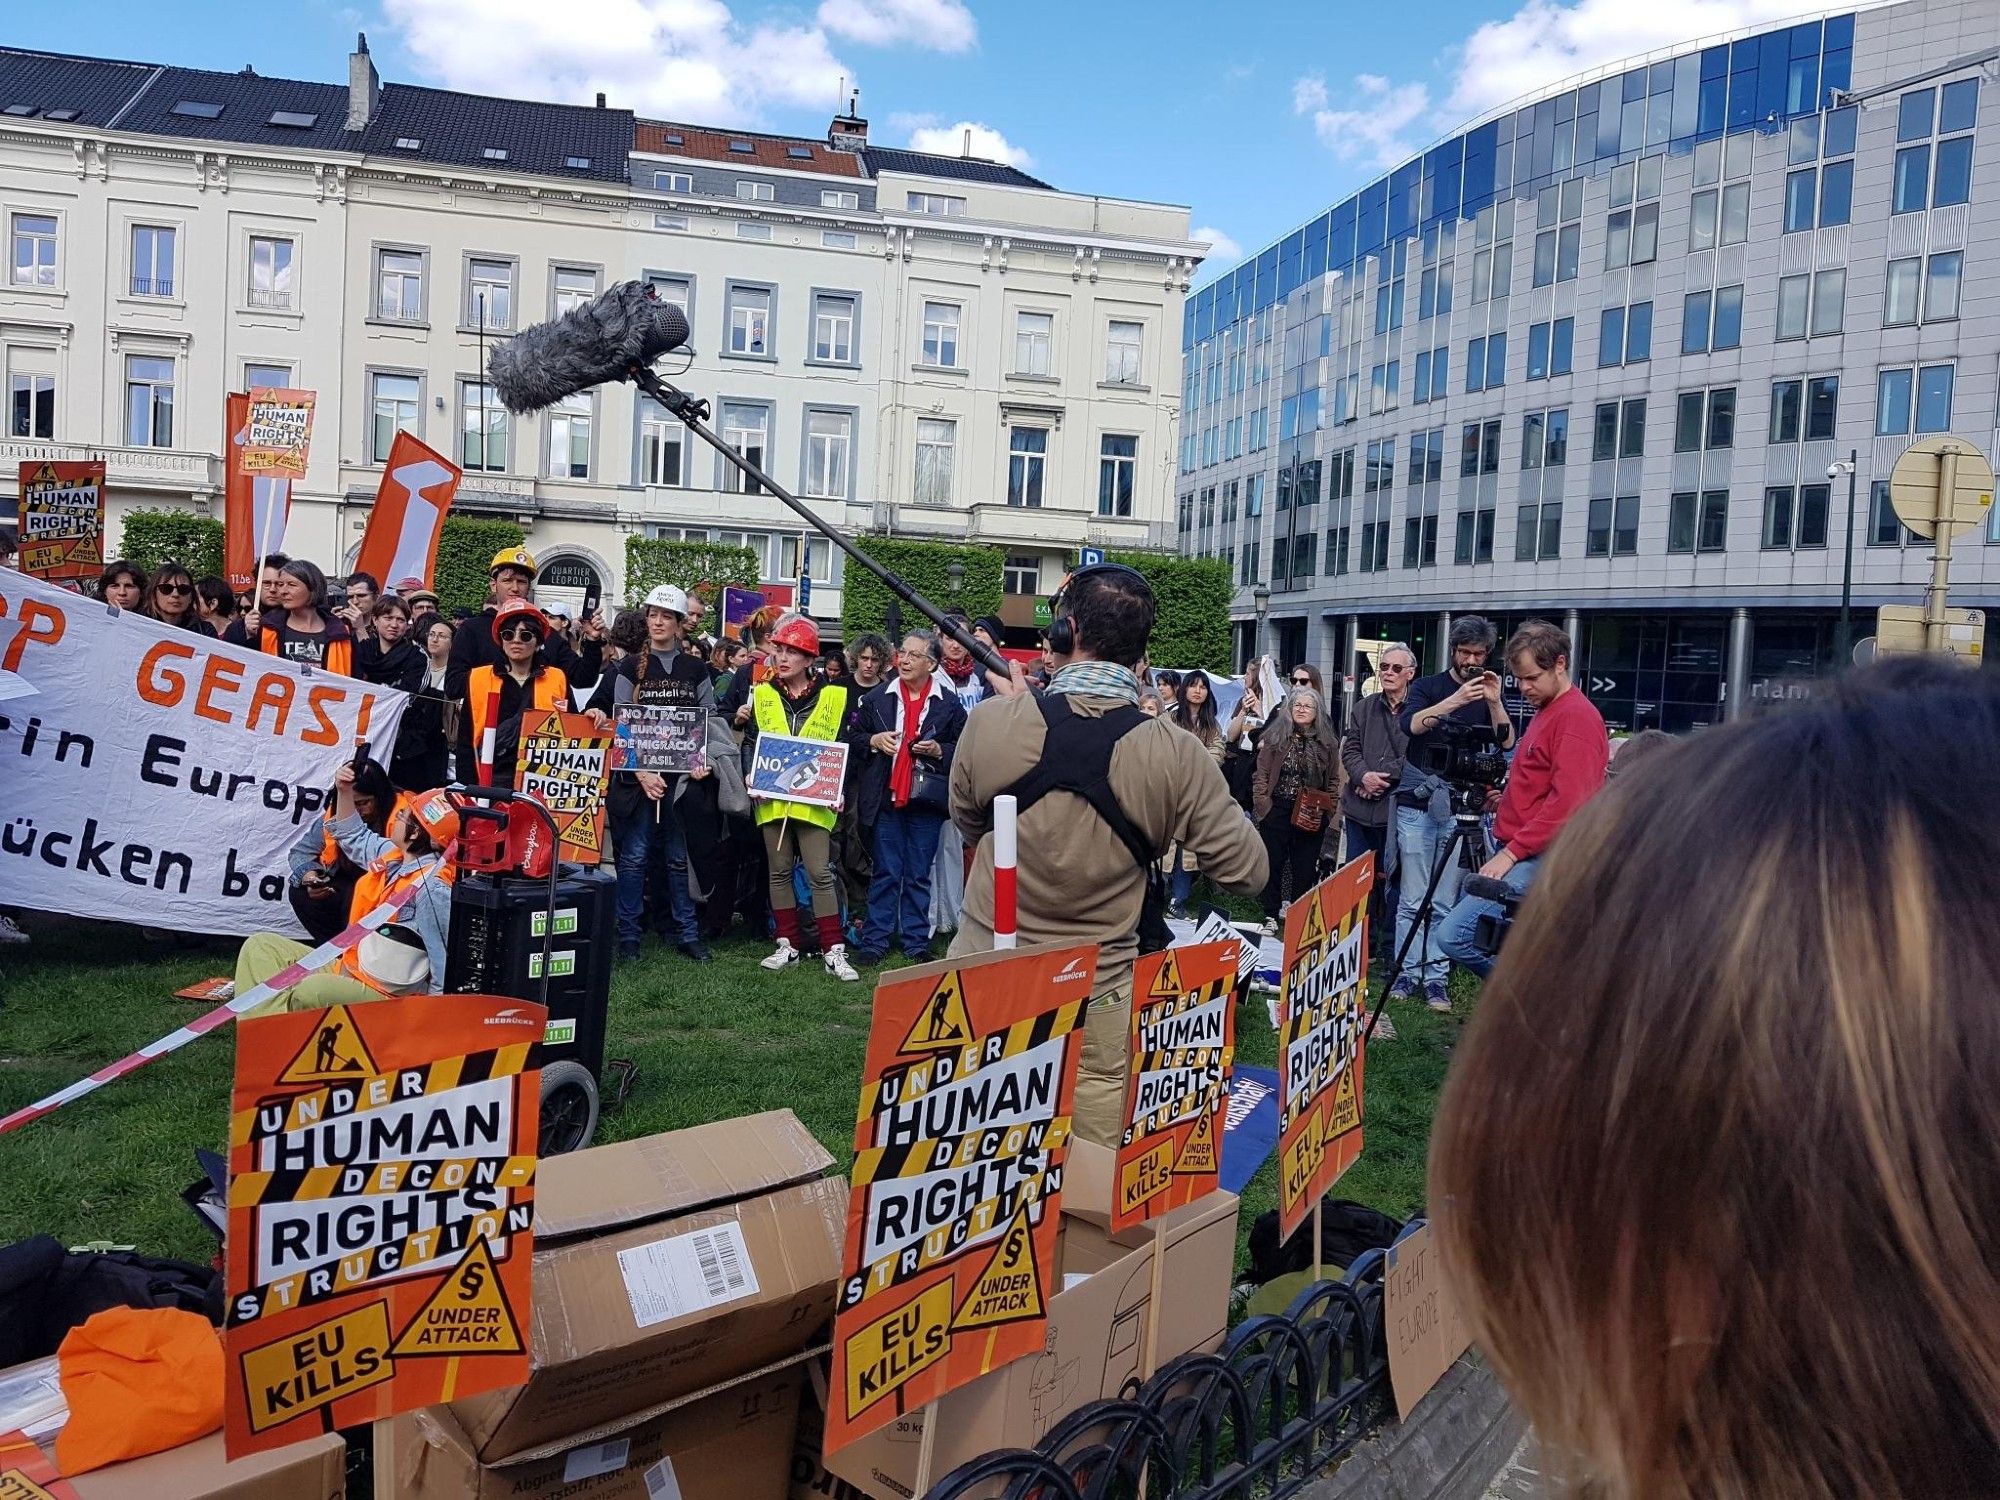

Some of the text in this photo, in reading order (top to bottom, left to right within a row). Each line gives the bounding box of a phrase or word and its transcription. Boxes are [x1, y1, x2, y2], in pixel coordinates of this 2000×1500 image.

[256, 409, 305, 424] HUMAN
[252, 427, 303, 440] RIGHTS
[247, 460, 274, 468] KILLS
[26, 481, 73, 493] UNDER
[30, 491, 96, 506] HUMAN
[21, 524, 104, 542] STRUCTION
[30, 516, 95, 530] RIGHTS
[29, 557, 62, 569] KILLS
[36, 549, 52, 558] EU
[71, 554, 97, 562] ATTACK
[231, 574, 251, 584] 11.be
[551, 566, 590, 576] QUARTIER
[551, 576, 590, 586] LEOPOLD
[0, 593, 376, 747] P GEAS!
[622, 708, 642, 720] NO
[643, 710, 659, 720] AL
[660, 711, 696, 722] PACTE
[630, 724, 686, 736] EUROPEU
[528, 739, 579, 749] UNDER
[618, 739, 698, 752] DE MIGRACIÓ
[823, 750, 843, 758] PACTE
[531, 750, 601, 773] HUMAN
[648, 755, 675, 766] ASIL
[757, 756, 782, 772] NO
[815, 761, 842, 769] EUROPEU
[140, 733, 331, 825] Europ
[526, 778, 598, 799] RIGHTS
[551, 768, 608, 787] DECON-
[546, 797, 606, 810] UCTION
[567, 833, 594, 846] ATTACK
[570, 826, 594, 839] UNDER
[221, 848, 289, 902] ba
[1290, 929, 1339, 990] UNDER
[1293, 941, 1358, 1018] HUMAN
[1140, 991, 1198, 1027] UNDER
[1311, 985, 1364, 1029] DECON-
[483, 1016, 535, 1026] SEEBRÜCKE
[1145, 1010, 1222, 1053] HUMAN
[1163, 1049, 1230, 1067] DECON-
[1290, 1005, 1356, 1091] RIGHTS
[882, 1035, 1002, 1106] UNDER
[1281, 1016, 1364, 1134] STRUCTION
[1138, 1064, 1219, 1112] RIGHTS
[261, 1071, 424, 1134] UNDER
[889, 1062, 1054, 1146] HUMAN
[1123, 1079, 1230, 1145] STRUCTION
[1333, 1095, 1355, 1118] UNDER
[1330, 1107, 1355, 1133] ATTACK
[275, 1101, 501, 1170] HUMAN
[935, 1124, 1063, 1167] DECON-
[1295, 1125, 1312, 1164] EU
[1185, 1142, 1211, 1154] UNDER
[1138, 1151, 1159, 1178] EU
[1182, 1155, 1211, 1167] ATTACK
[1288, 1140, 1321, 1201] KILLS
[343, 1161, 524, 1193] DECON-
[1126, 1166, 1169, 1205] KILLS
[874, 1149, 1041, 1247] RIGHTS
[271, 1186, 499, 1267] RIGHTS
[846, 1167, 1061, 1305] STRUCTION
[236, 1207, 529, 1320] STRUCTION
[980, 1273, 1031, 1297] UNDER
[1389, 1248, 1428, 1305] FIGHT
[426, 1307, 501, 1325] UNDER
[970, 1292, 1031, 1318] ATTACK
[416, 1326, 502, 1345] ATTACK
[881, 1303, 922, 1353] EU
[292, 1325, 345, 1372] EU
[858, 1323, 943, 1401] KILLS
[265, 1346, 380, 1415] KILLS
[896, 1422, 909, 1432] 30
